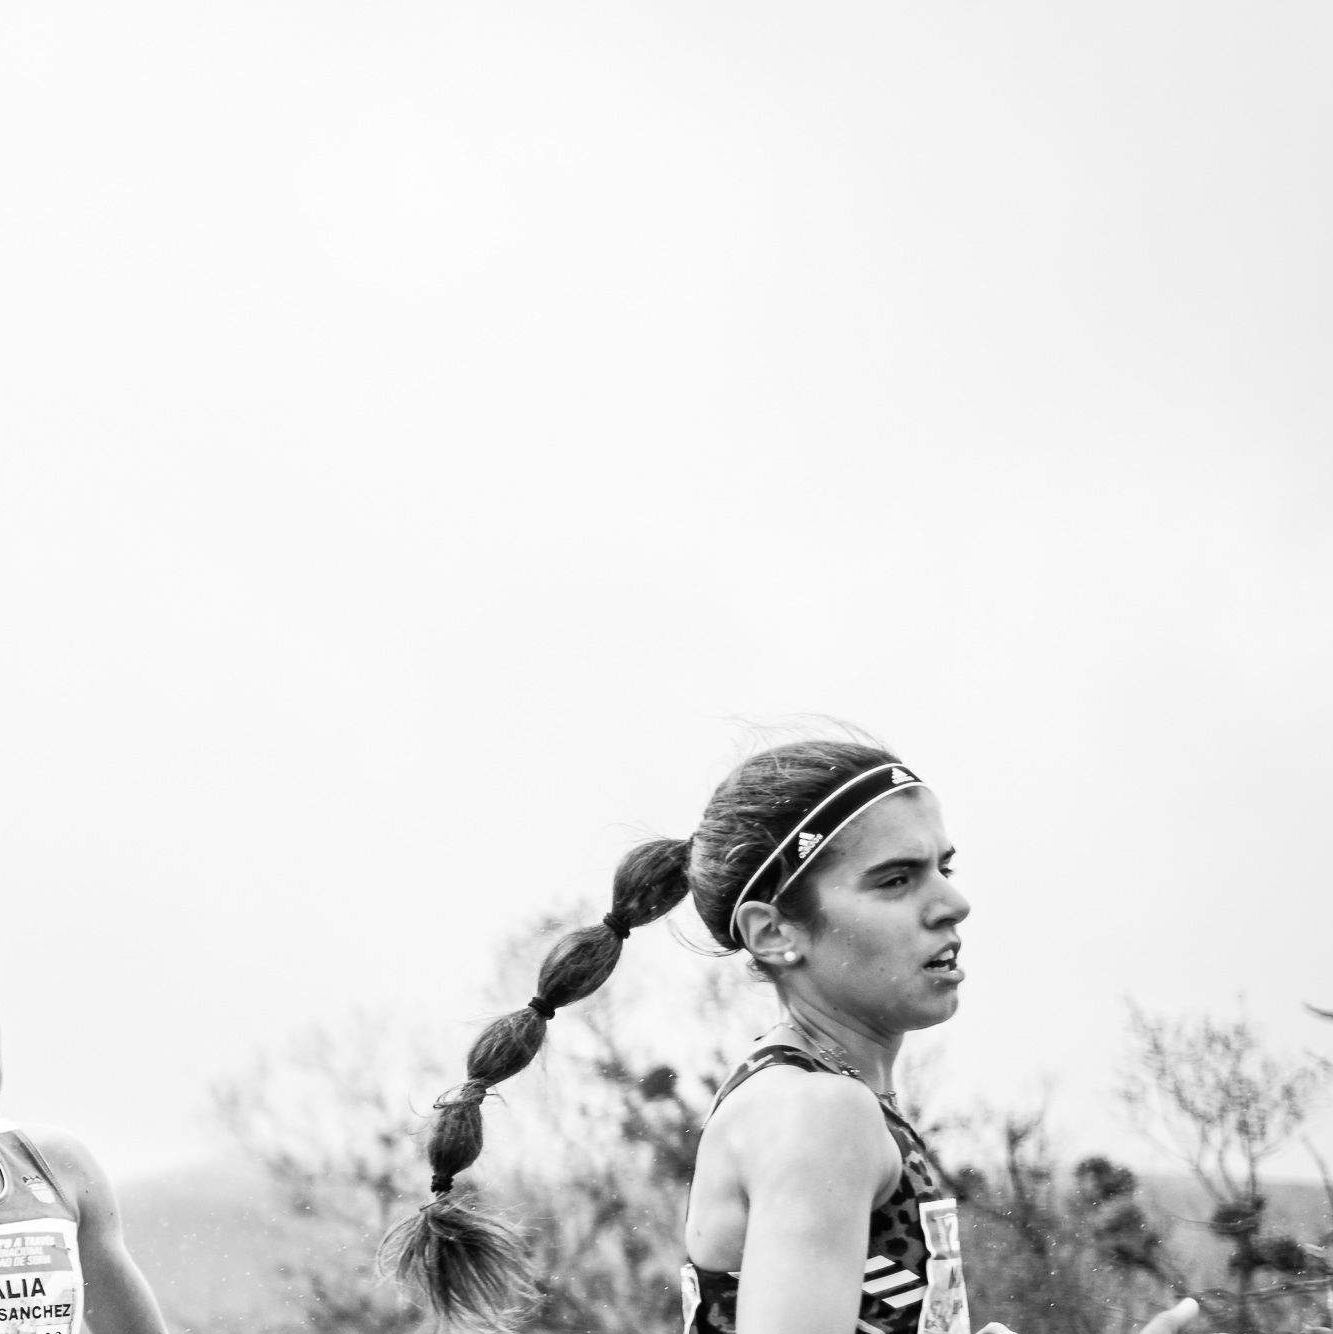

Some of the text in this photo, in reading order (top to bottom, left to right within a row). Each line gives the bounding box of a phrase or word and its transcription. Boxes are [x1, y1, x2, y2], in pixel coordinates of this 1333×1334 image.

[13, 1238, 22, 1249] A
[13, 1256, 26, 1267] DE
[27, 1254, 52, 1265] SORIA
